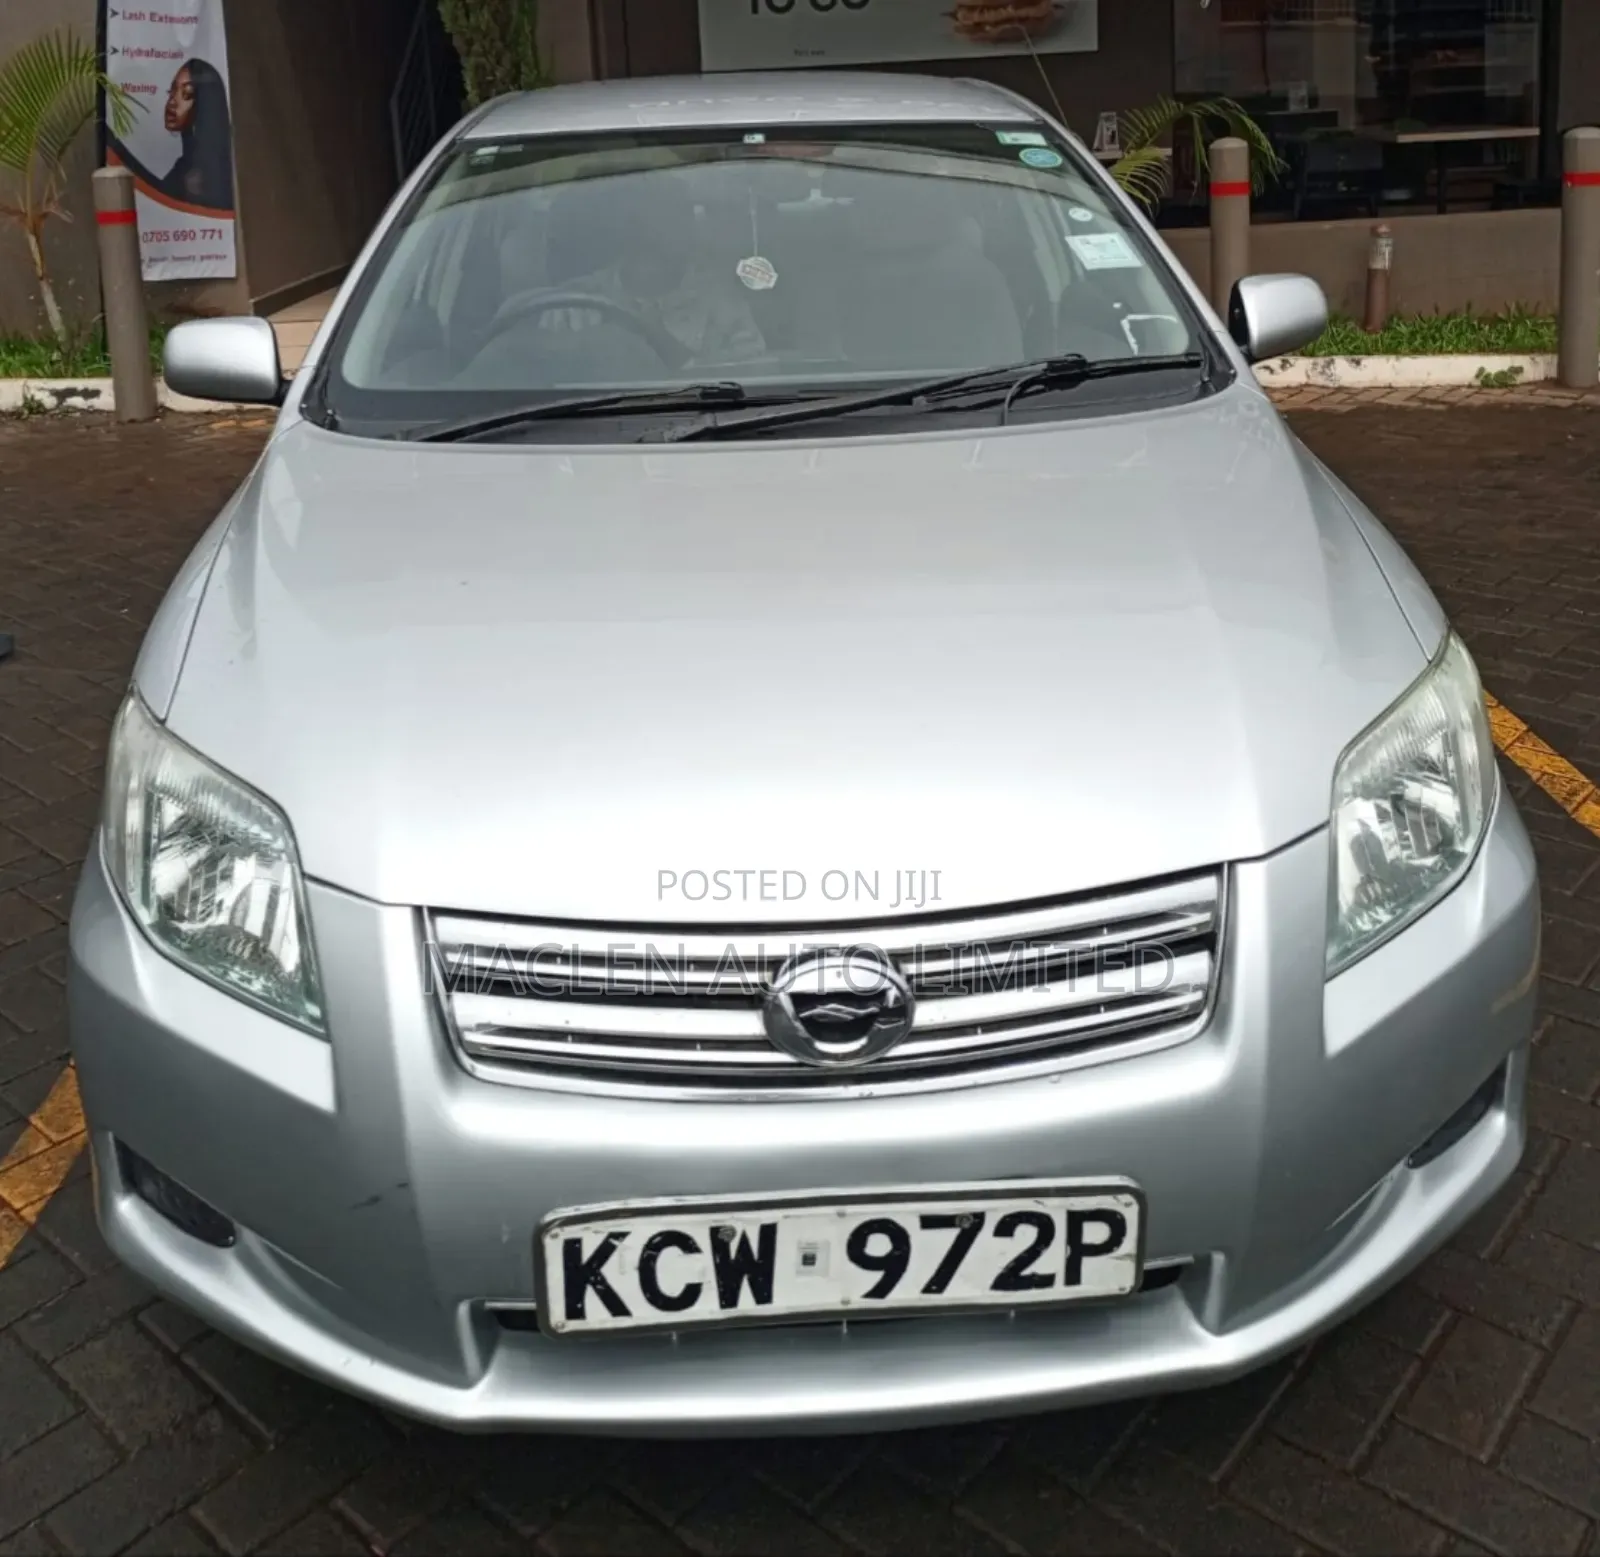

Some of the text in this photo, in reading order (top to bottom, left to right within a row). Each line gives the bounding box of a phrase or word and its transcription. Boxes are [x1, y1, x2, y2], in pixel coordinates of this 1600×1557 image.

[122, 9, 146, 21] Lash
[121, 82, 158, 95] Waxing
[142, 228, 223, 243] 0705 690 771
[562, 1209, 1128, 1321] KCW 972P
